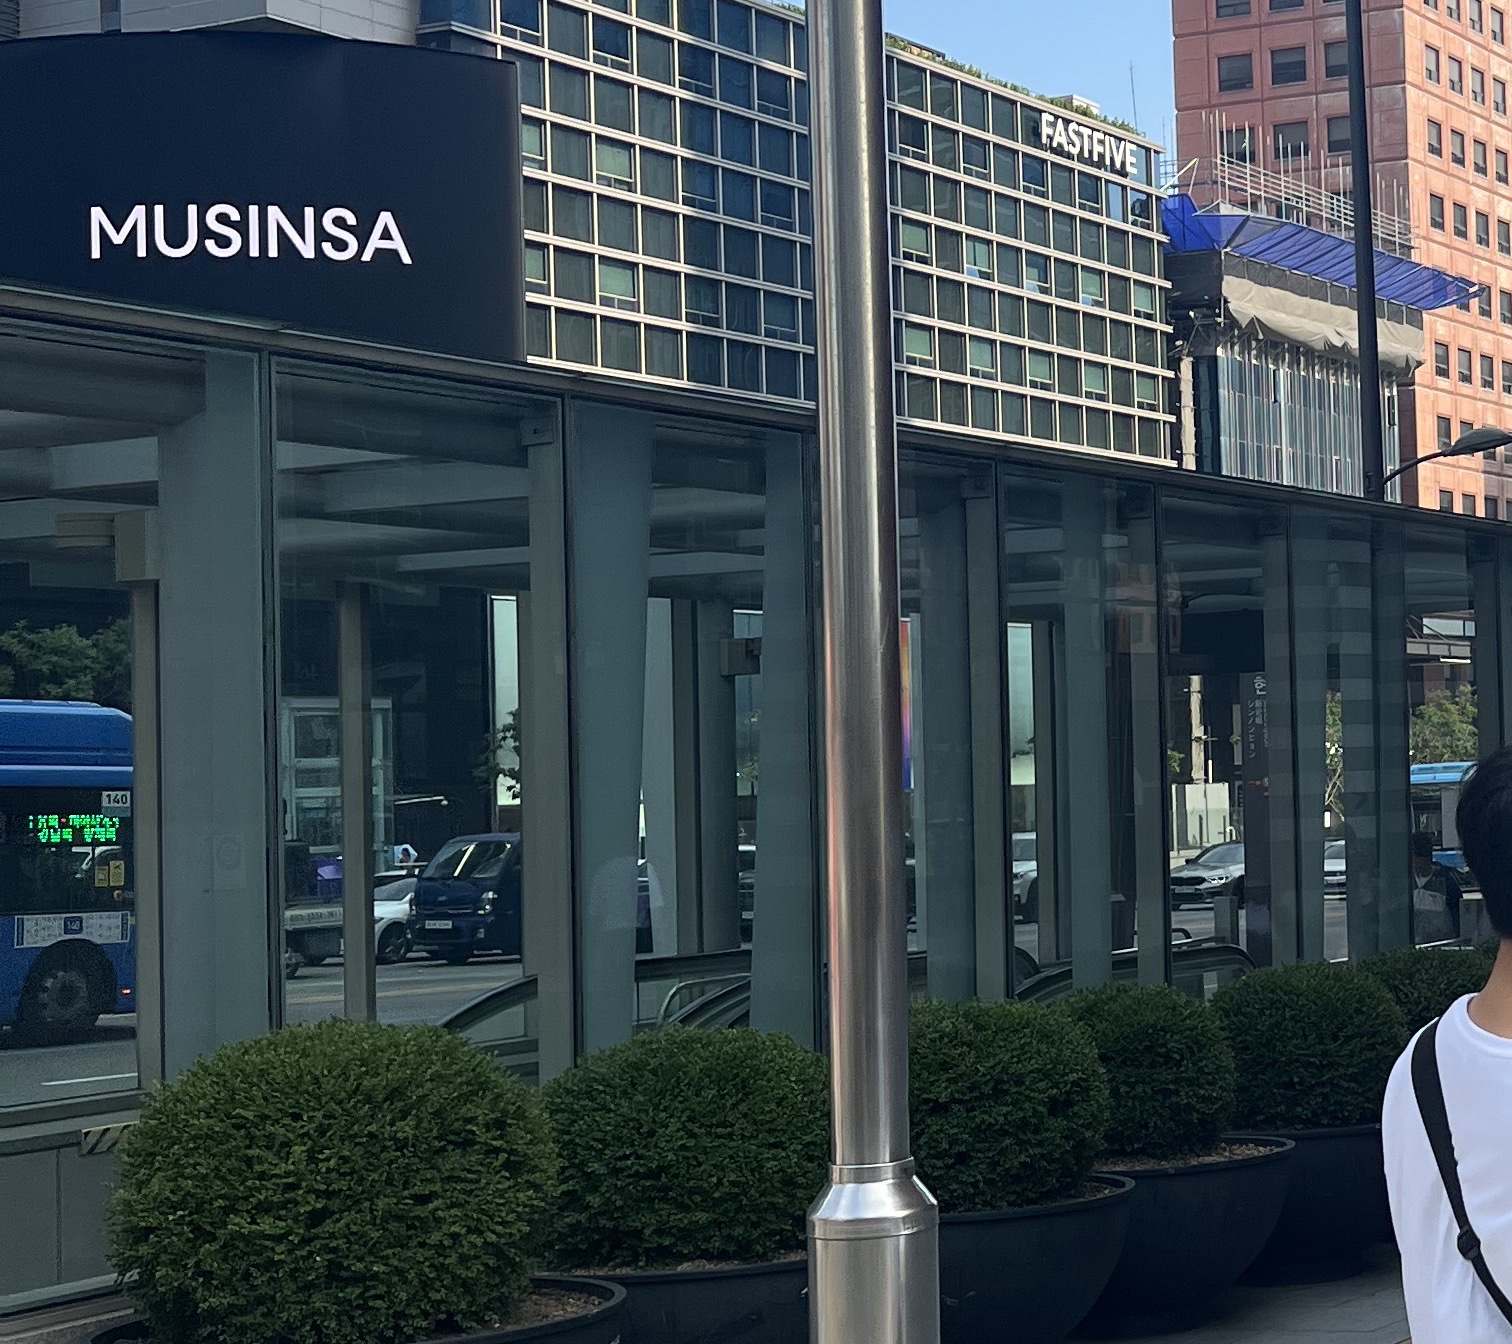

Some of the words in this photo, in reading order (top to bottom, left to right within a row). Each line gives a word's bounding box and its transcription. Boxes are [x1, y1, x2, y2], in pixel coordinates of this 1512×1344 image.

[1041, 112, 1138, 175] FASTFIVE
[90, 203, 413, 265] MUSINSA
[105, 793, 128, 806] 140
